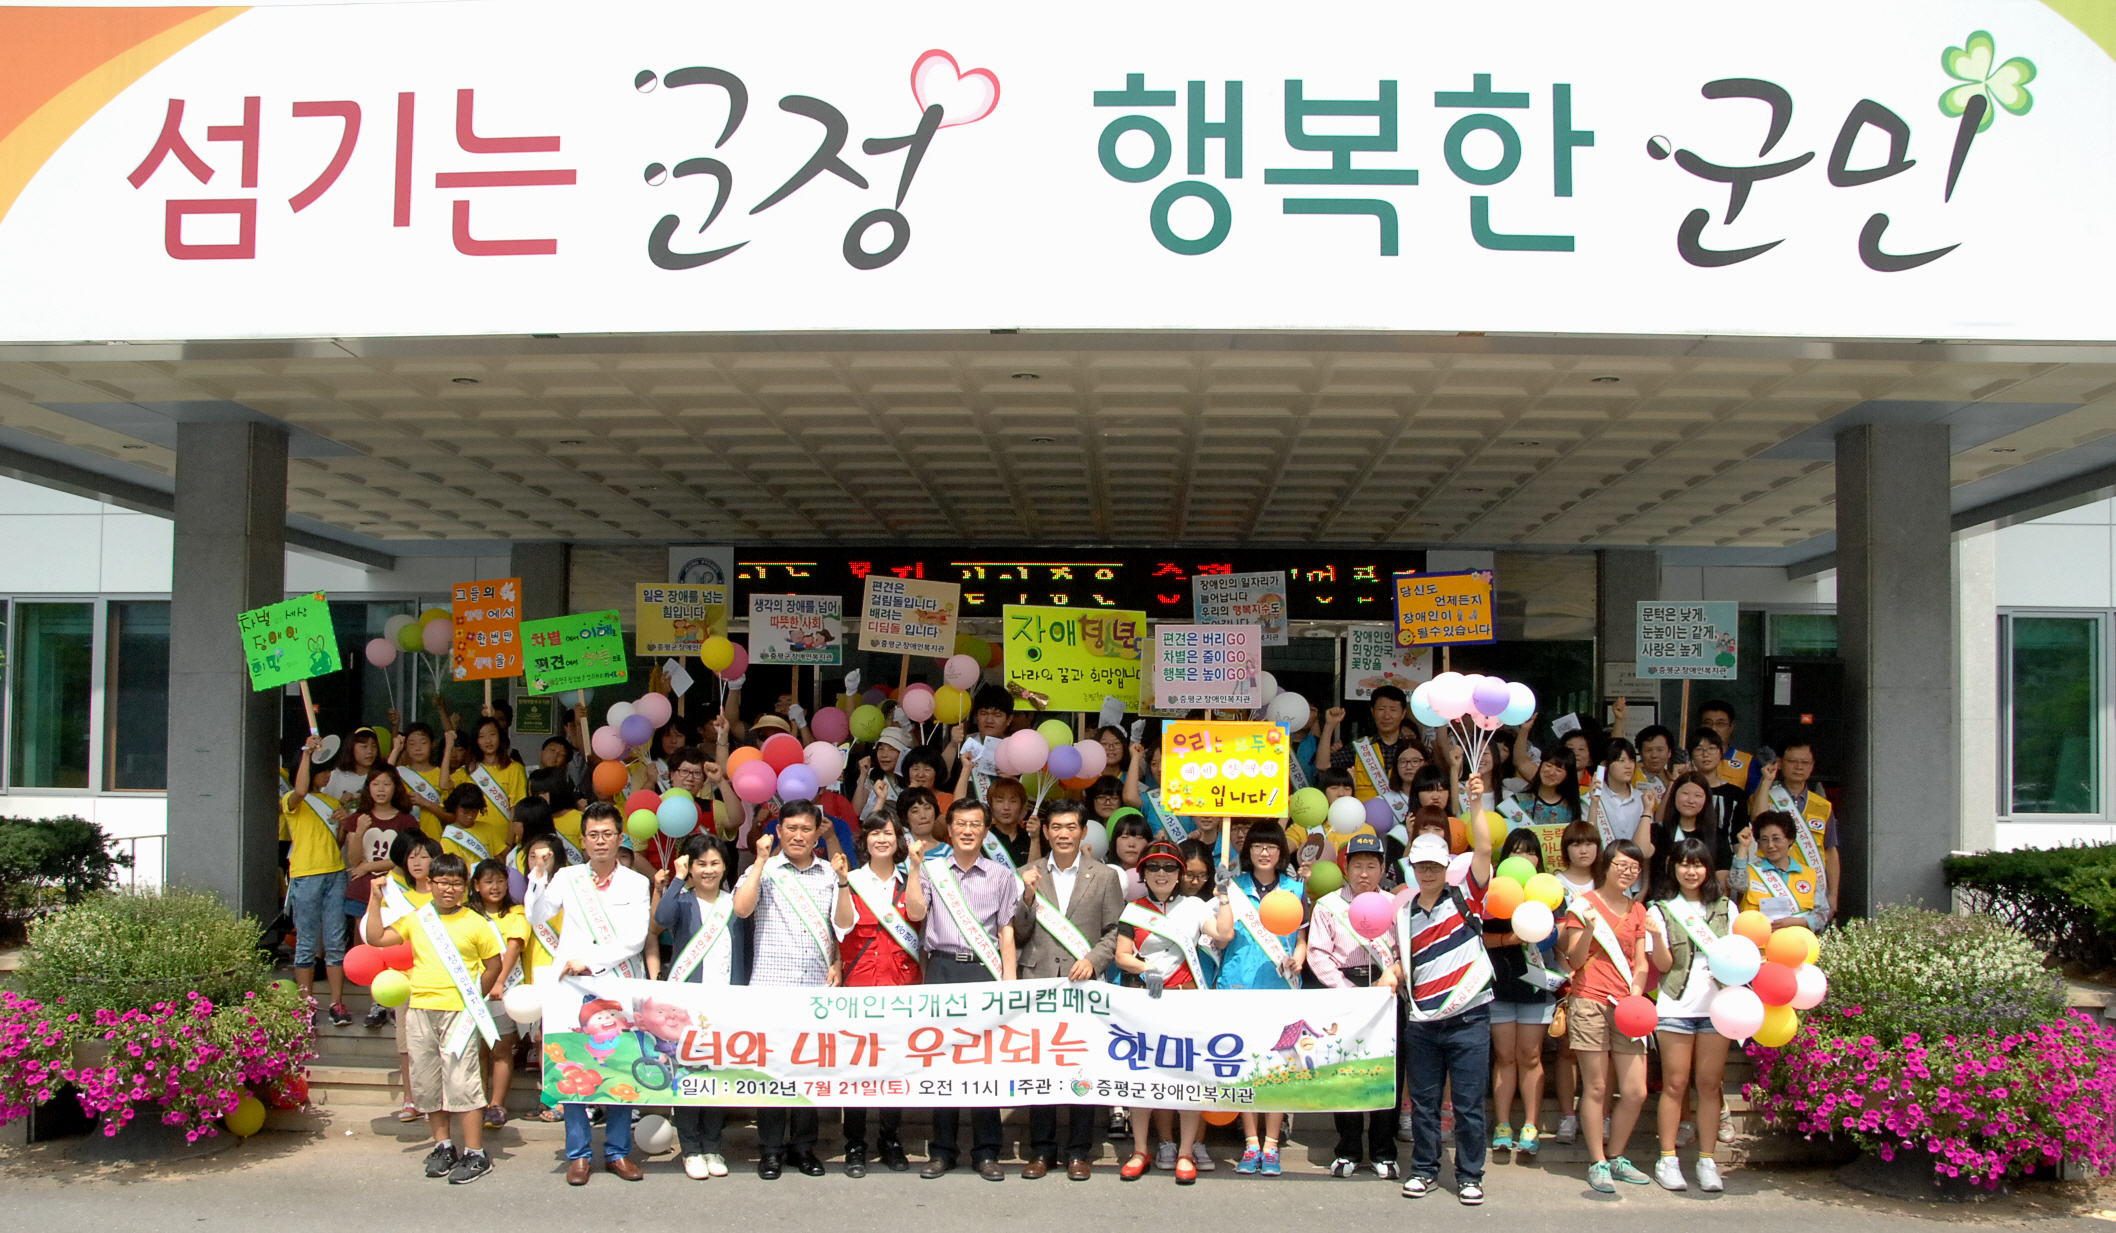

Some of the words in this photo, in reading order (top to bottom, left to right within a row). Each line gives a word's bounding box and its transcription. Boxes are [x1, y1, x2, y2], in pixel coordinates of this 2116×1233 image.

[127, 89, 576, 260] 섬기는
[1094, 73, 1595, 256] 행복한
[1647, 78, 1988, 272] 군민
[872, 581, 905, 594] 편견은
[1200, 578, 1238, 590] 장애인의
[1241, 576, 1279, 589] 일자리가
[1400, 584, 1438, 597] 당신도
[455, 586, 496, 602] 그들의
[643, 589, 665, 603] 일은
[667, 590, 699, 603] 장애를
[702, 590, 723, 604] 넘는
[1200, 591, 1248, 604] 늘어납니다
[1435, 594, 1482, 607] 언제든지
[754, 599, 783, 613] 생각의
[786, 600, 815, 614] 장애를
[818, 600, 837, 614] 넘어
[871, 594, 937, 610] 걸림돌입니다
[464, 606, 515, 621] 에서
[663, 605, 705, 619] 힘입니다
[870, 608, 902, 620] 배려는
[1201, 605, 1229, 618] 우리의
[1233, 603, 1280, 616] 행복지수도
[1403, 610, 1452, 624] 장애인이
[1643, 607, 1676, 622] 문턱은
[1680, 607, 1706, 622] 낮게,
[770, 616, 799, 629] 따뜻한
[802, 616, 821, 629] 사회
[868, 621, 901, 634] 디딤돌
[905, 624, 938, 638] 입니다
[1163, 632, 1198, 647] 편견은
[1202, 632, 1246, 647] 버리GO
[1353, 630, 1393, 643] 장애인의
[1642, 625, 1687, 640] 눈높이는
[1692, 625, 1718, 640] 같게,
[679, 643, 702, 652] 장애인
[881, 640, 901, 648] 증평군
[1642, 643, 1675, 657] 사랑은
[1680, 643, 1702, 657] 높게
[1163, 650, 1198, 664] 차별은
[1202, 650, 1246, 664] 줄이GO
[1012, 668, 1053, 681] 나라의
[1058, 667, 1084, 683] 꿈과
[1163, 667, 1198, 682] 행복은
[1202, 667, 1246, 682] 높이GO
[1659, 667, 1680, 675] 증평군
[1682, 667, 1726, 675] 장애인복지관
[1180, 695, 1202, 704] 증평군
[1204, 695, 1250, 704] 장애인복지관
[1171, 730, 1223, 759] 우리는
[809, 993, 967, 1020] 장애인식개선
[982, 988, 1111, 1016] 거리캠페인
[681, 1030, 775, 1067] 너와
[790, 1029, 886, 1068] 내가
[905, 1021, 1090, 1068] 우리되는
[1108, 1023, 1247, 1078] 한마음
[682, 1078, 716, 1096] 일시
[736, 1080, 796, 1097] 2012년
[804, 1080, 831, 1097] 7월
[839, 1079, 911, 1097] 21일(토)
[918, 1080, 953, 1097] 오전
[961, 1079, 998, 1097] 11시
[1017, 1078, 1052, 1096] 주관
[1096, 1079, 1147, 1100] 증평군
[1150, 1082, 1255, 1104] 장애인복지관
